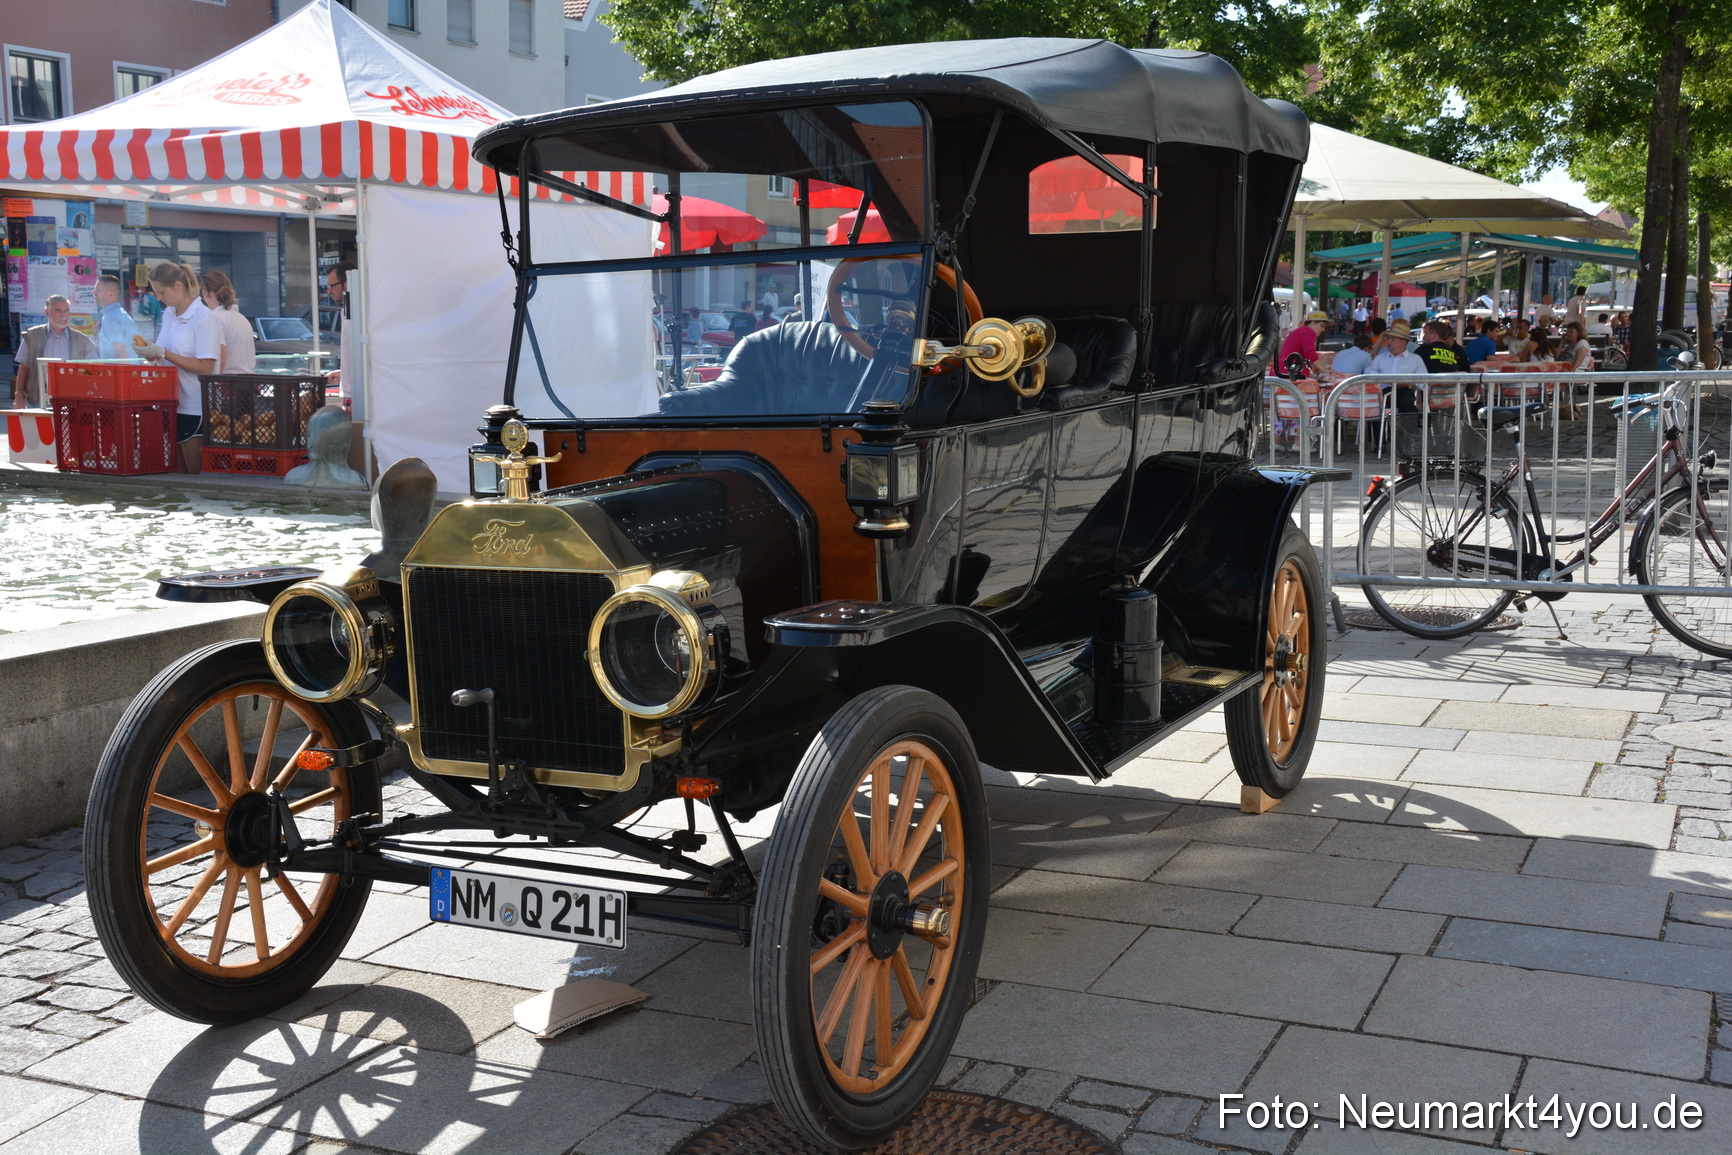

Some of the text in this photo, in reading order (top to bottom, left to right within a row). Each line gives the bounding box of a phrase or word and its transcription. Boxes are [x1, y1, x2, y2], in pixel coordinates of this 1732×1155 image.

[220, 91, 294, 105] IMBISS
[74, 264, 91, 275] G6
[1432, 347, 1455, 359] THW
[472, 518, 534, 555] Ford
[437, 900, 445, 912] D
[451, 876, 622, 941] NM Q 21H
